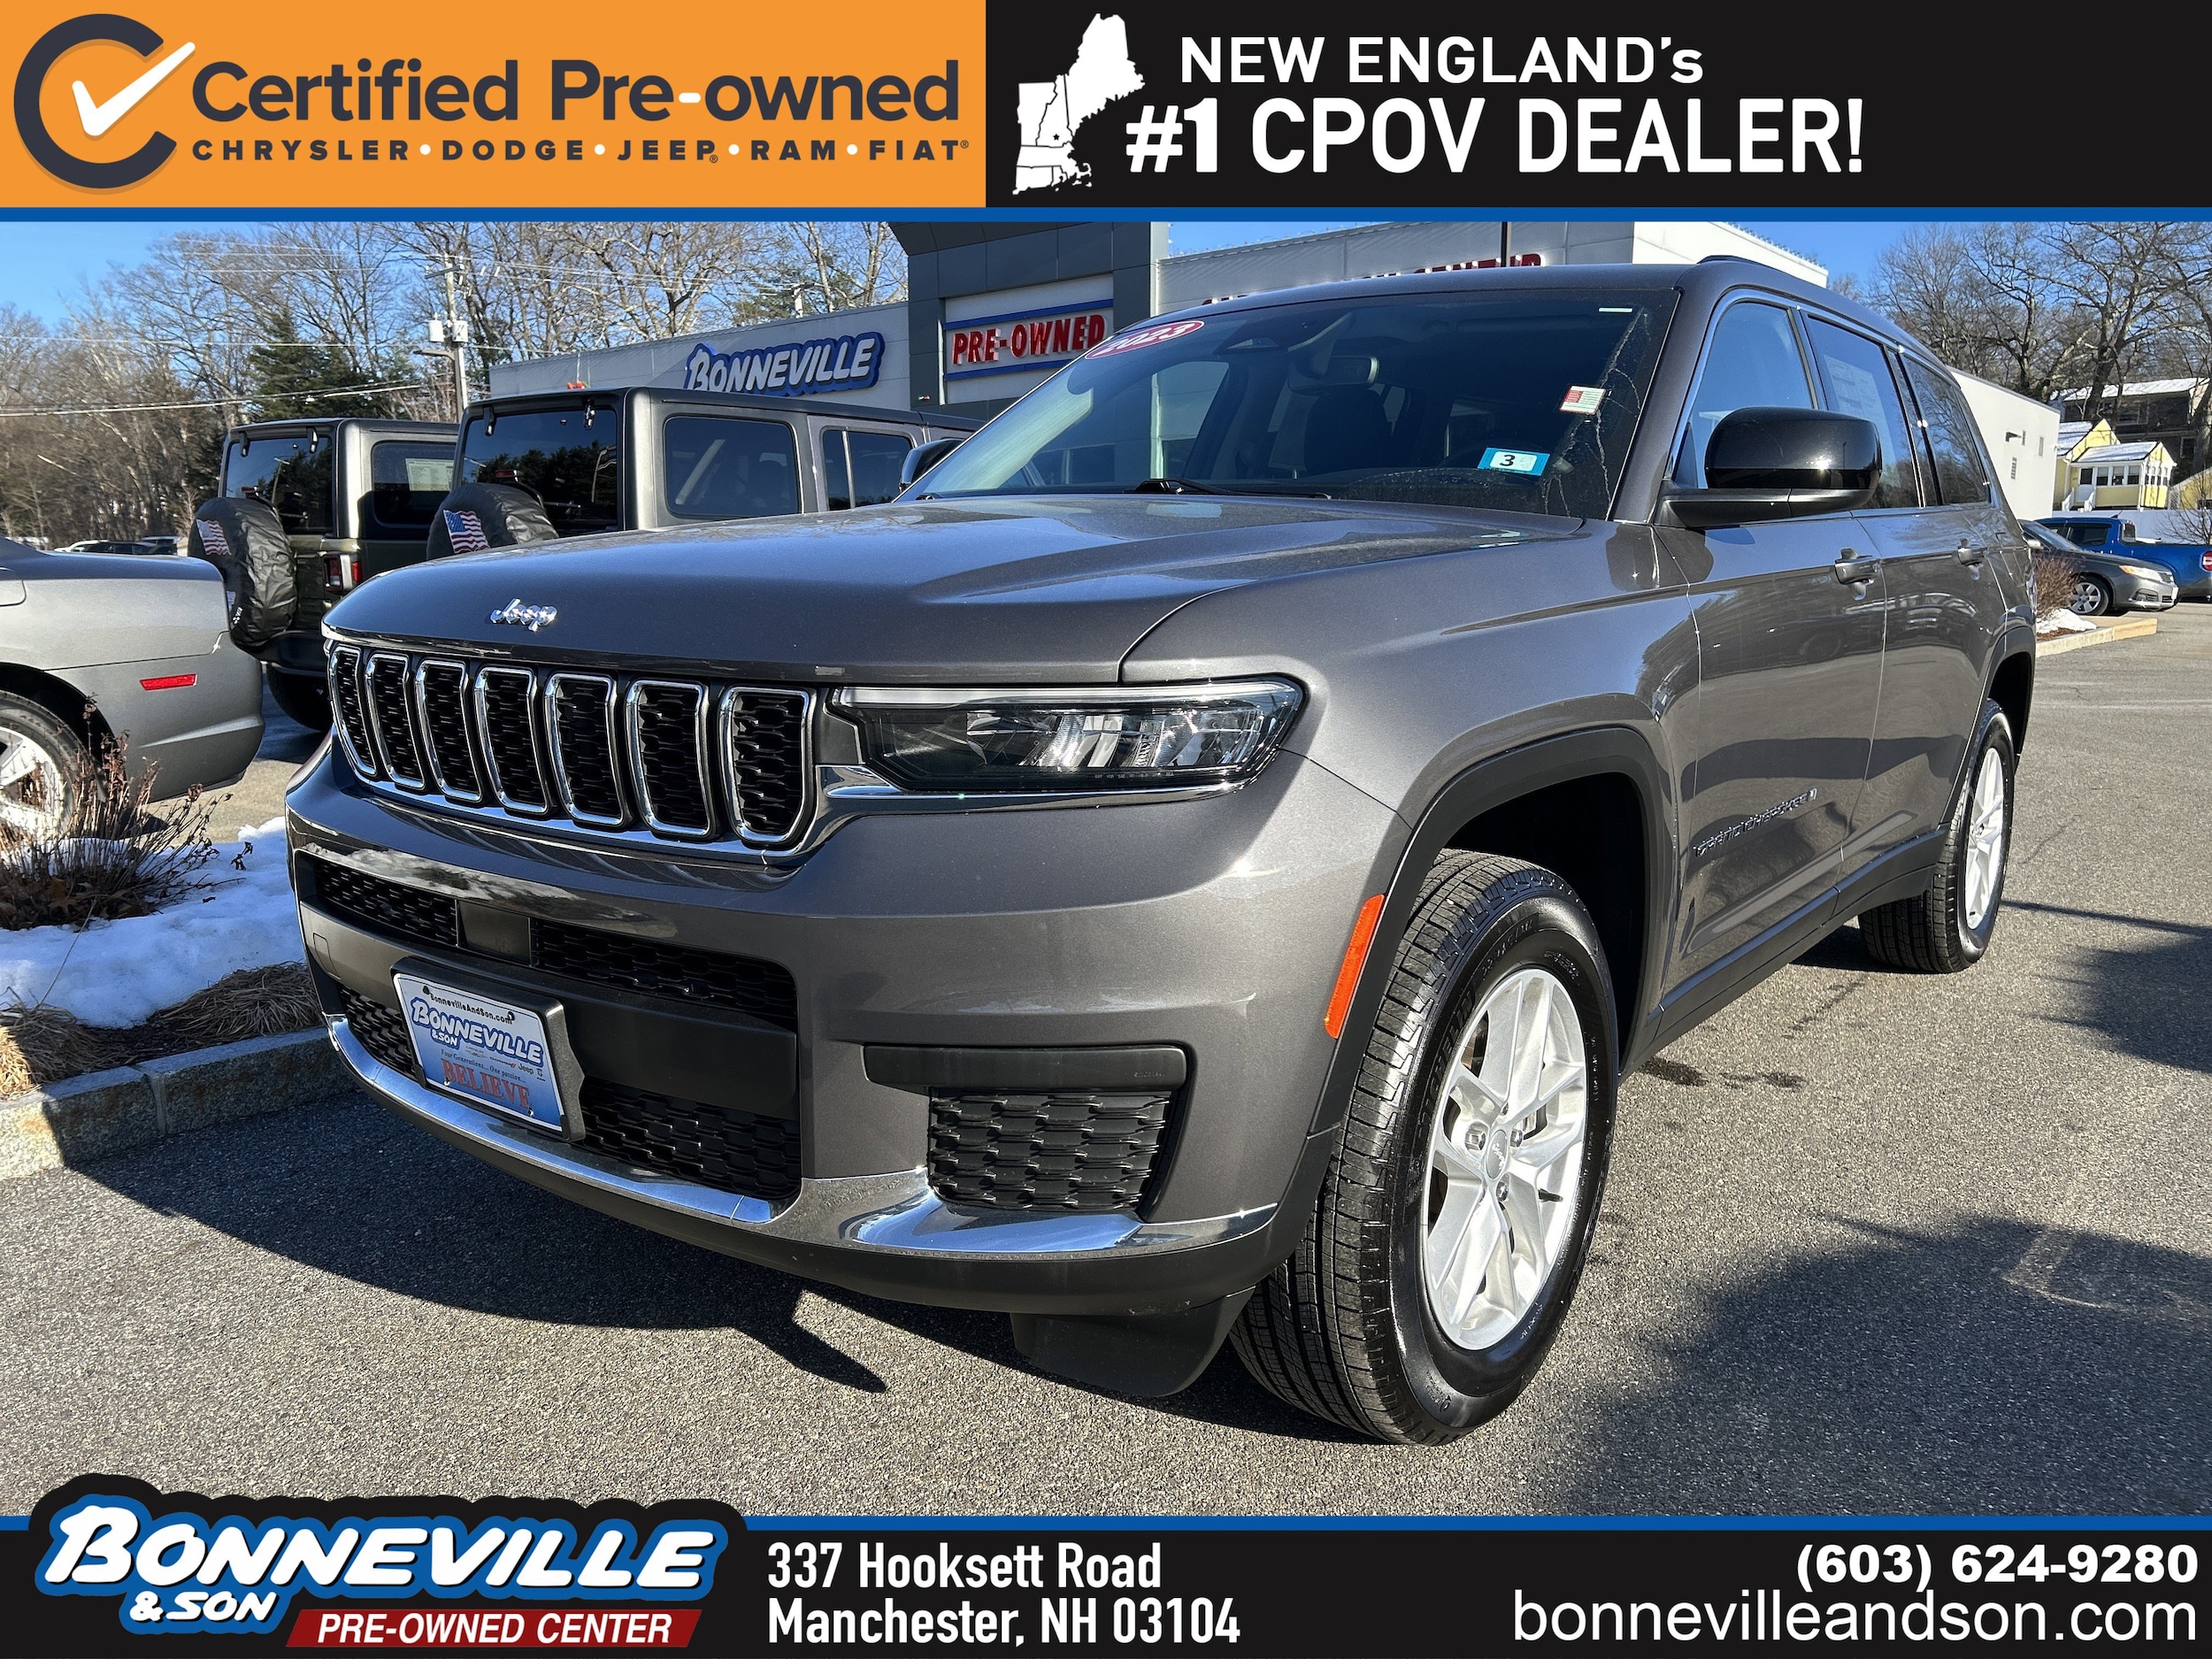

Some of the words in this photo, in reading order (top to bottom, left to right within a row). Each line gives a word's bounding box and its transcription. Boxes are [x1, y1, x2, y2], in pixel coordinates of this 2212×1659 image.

[952, 314, 1105, 365] PRE-OWNED
[1092, 323, 1195, 357] 2023
[687, 338, 876, 393] BONNEVILLE
[1499, 454, 1516, 466] 3
[490, 598, 557, 632] Jeep
[411, 999, 541, 1064] BONNEVILLE
